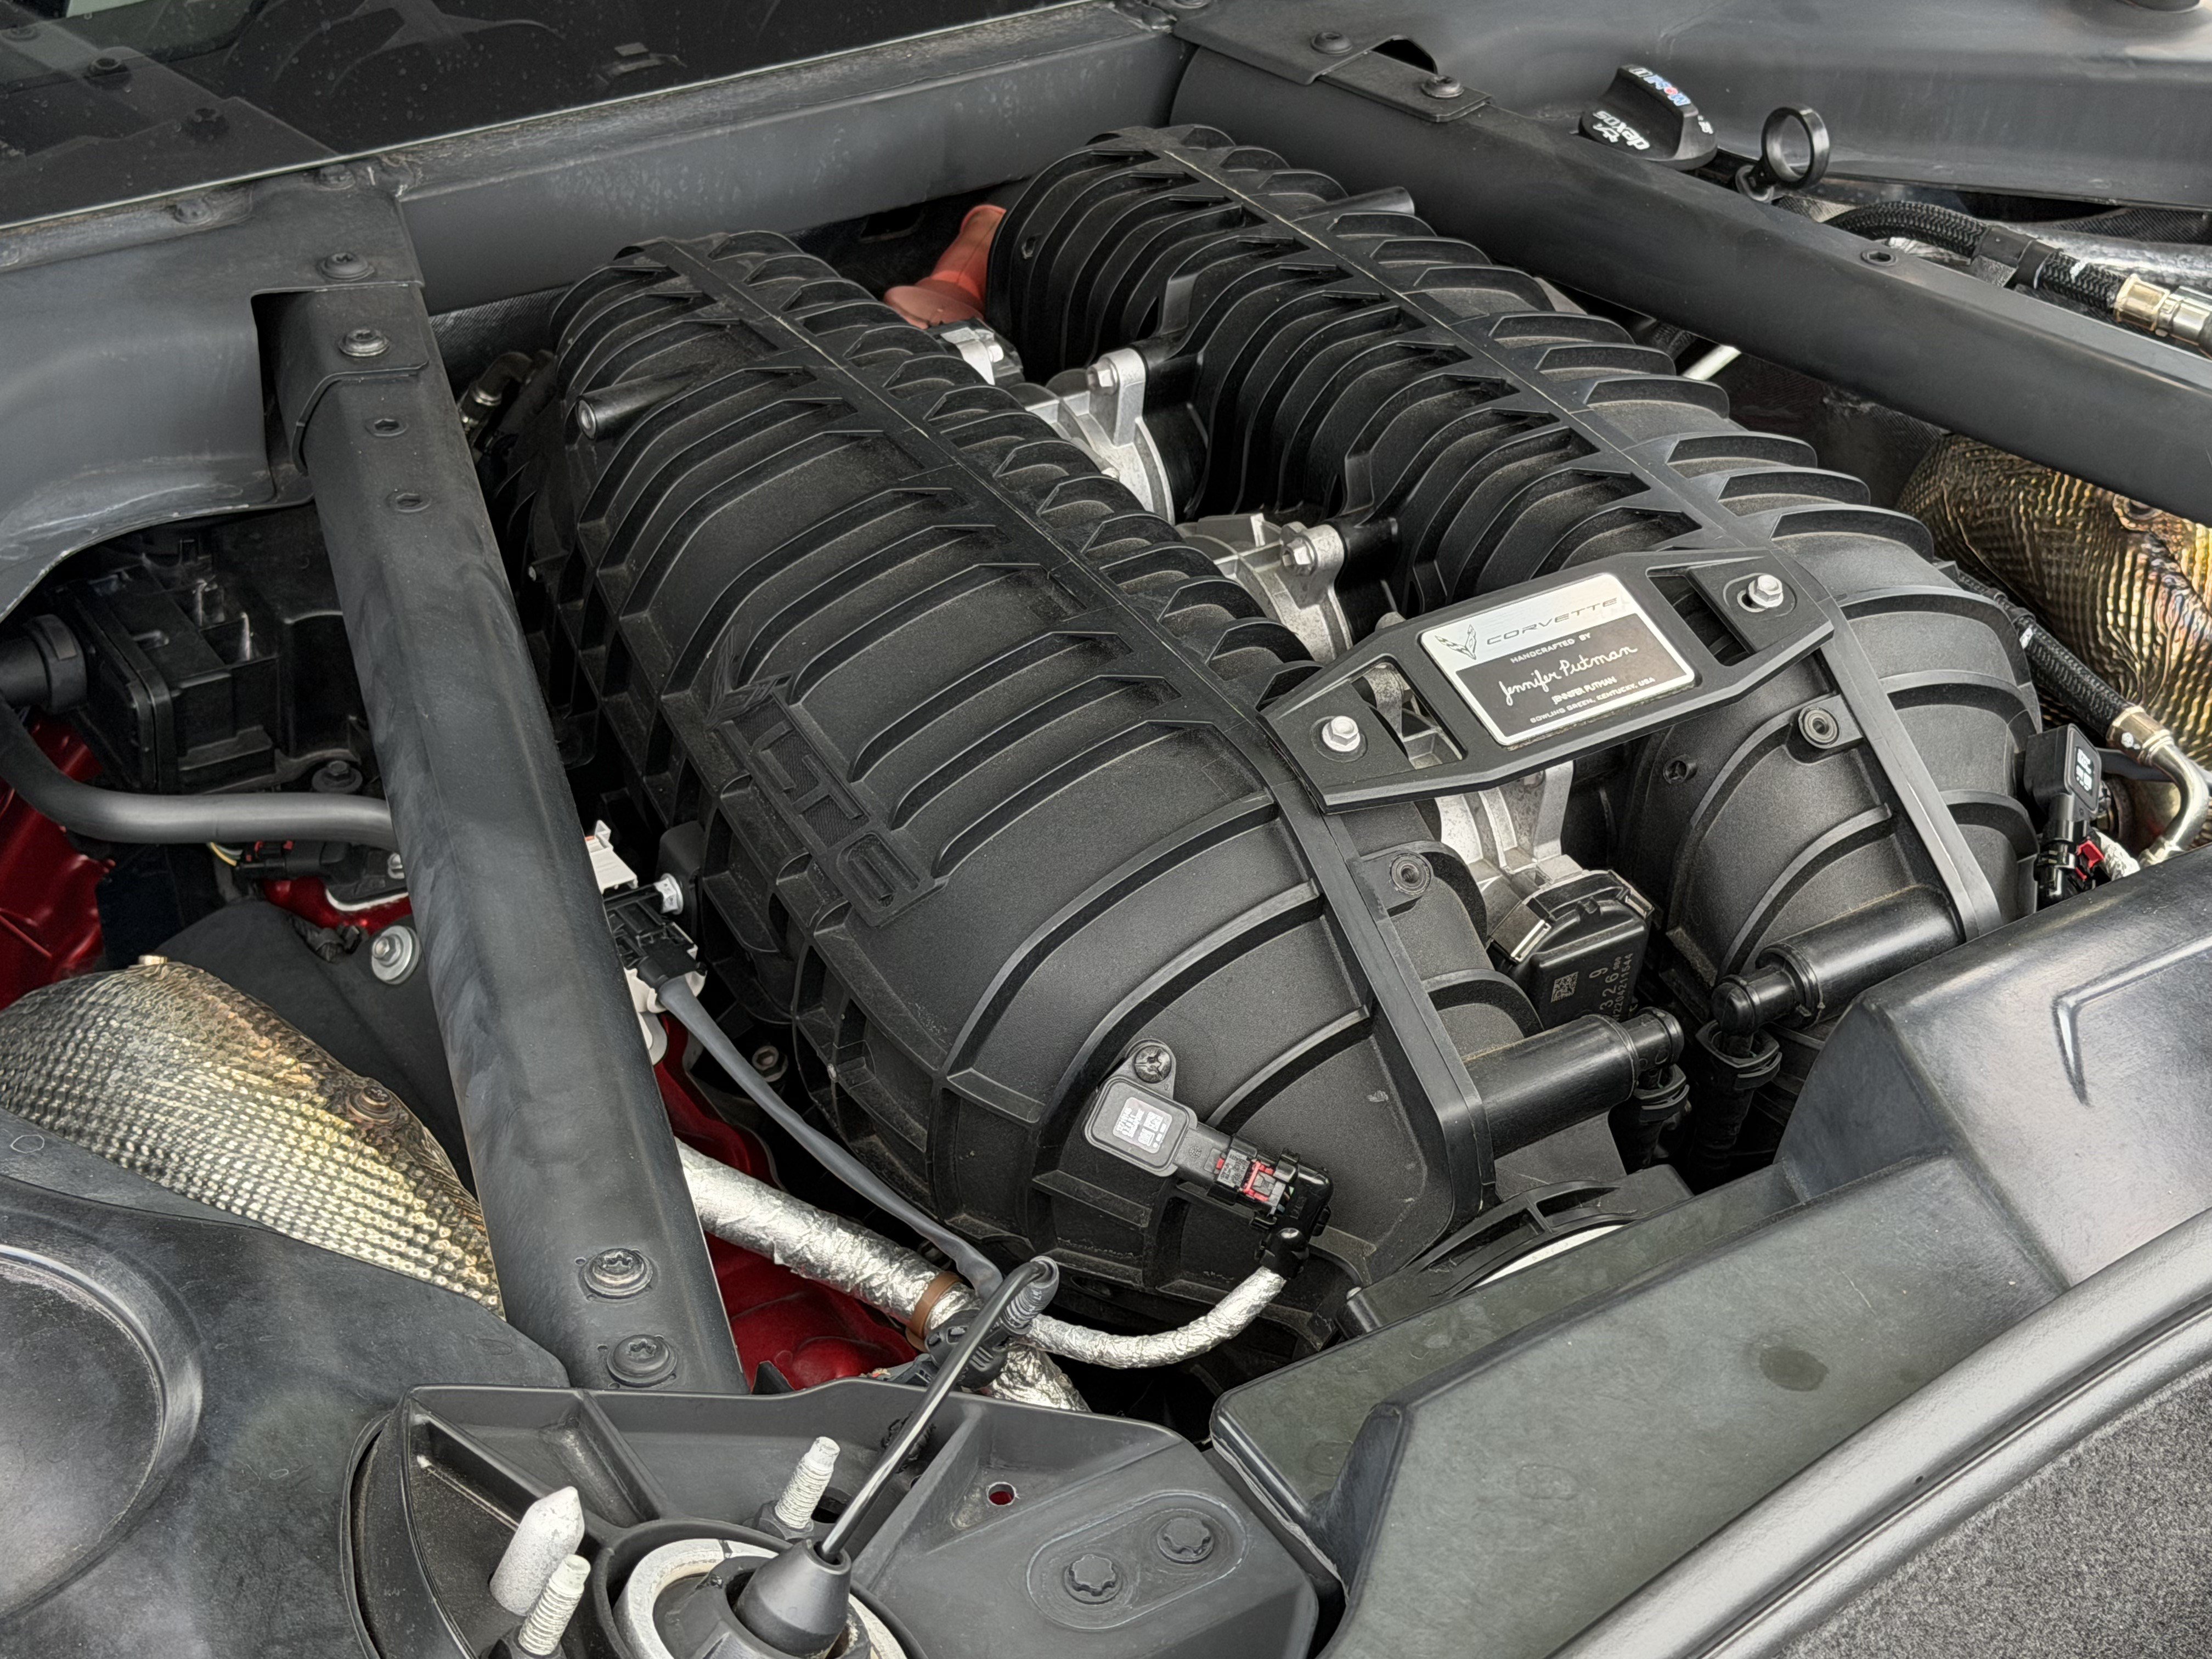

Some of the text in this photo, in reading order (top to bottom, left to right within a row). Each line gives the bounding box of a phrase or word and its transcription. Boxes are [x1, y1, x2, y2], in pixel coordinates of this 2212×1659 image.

[1593, 110, 1650, 150] dexos
[1487, 597, 1617, 646] CORVETTE
[1510, 632, 1592, 664] HANDCRAFTED BY
[1498, 646, 1638, 707] Jennifer Putman
[1551, 675, 1618, 706] JENNIFER PUTMAN
[1530, 708, 1566, 724] BOWLING
[1638, 676, 1656, 687] USA
